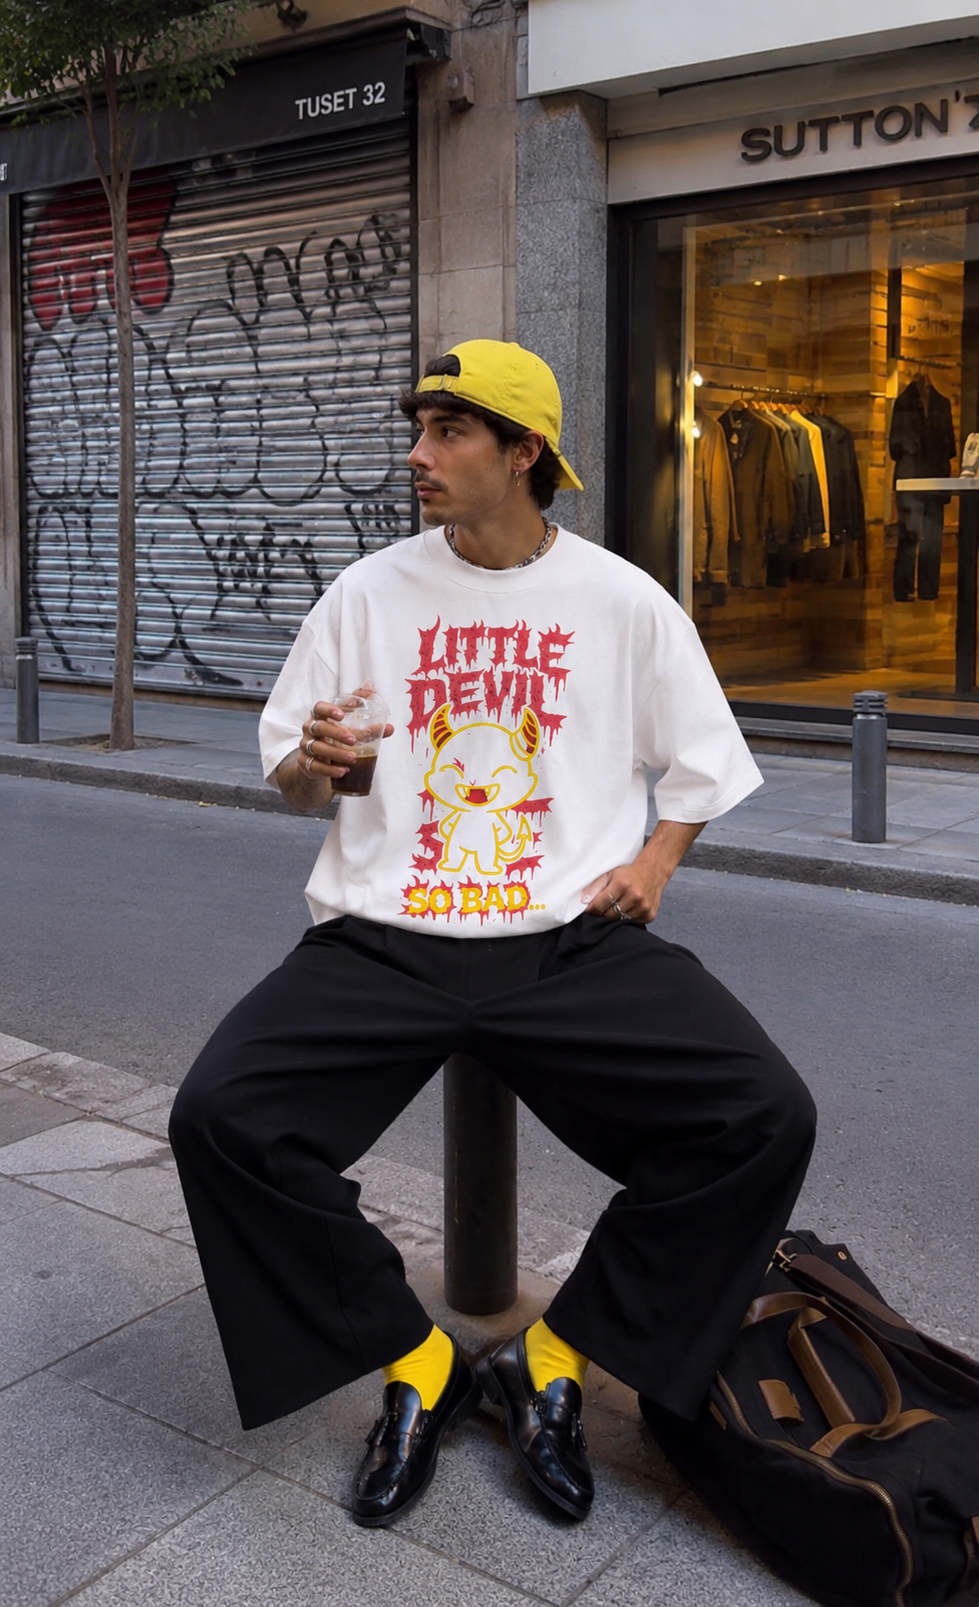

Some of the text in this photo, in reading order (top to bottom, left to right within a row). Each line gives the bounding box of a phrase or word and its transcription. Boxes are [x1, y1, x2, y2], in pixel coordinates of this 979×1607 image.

[295, 82, 386, 120] TUSET 32
[411, 616, 576, 690] LITTLE
[405, 667, 567, 742] DEVIL
[402, 881, 455, 918] SO
